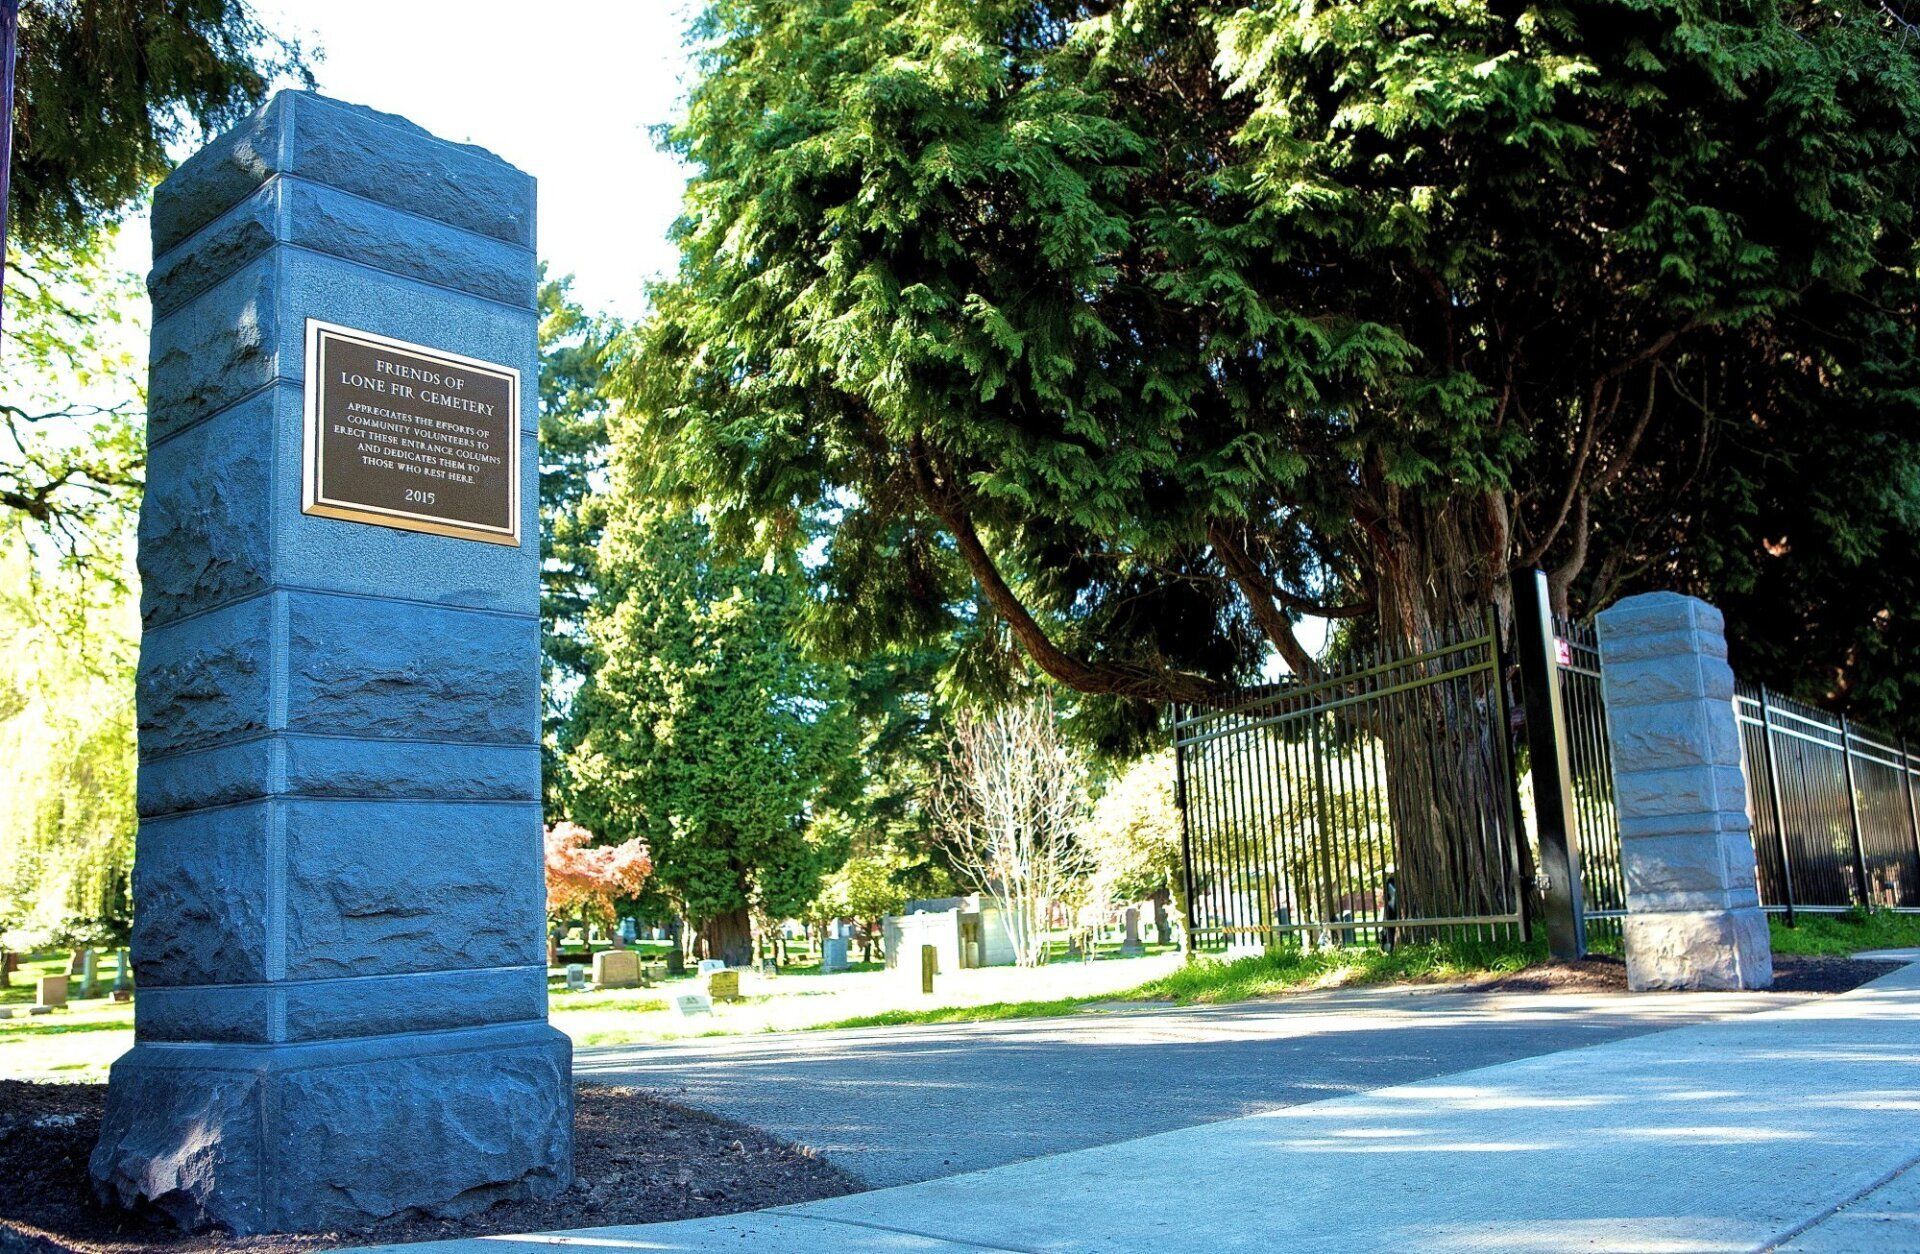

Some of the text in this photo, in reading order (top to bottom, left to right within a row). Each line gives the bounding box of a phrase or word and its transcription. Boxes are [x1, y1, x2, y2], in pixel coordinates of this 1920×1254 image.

[376, 359, 465, 391] FRIENDS OF
[341, 371, 495, 416] LONE FIR CEMETERY
[347, 402, 490, 439] APPRECIATES THE EFFORTS OF
[347, 415, 489, 451] COMMUNITY VOLUNTEERS TO
[334, 424, 501, 465] ERECT THESE ENTRANCE COLUMNS
[357, 442, 480, 473] AND DEDICATES THEM TO
[362, 455, 394, 469] THOSE
[397, 462, 422, 474] WHO
[424, 467, 446, 479] REST
[405, 488, 436, 505] 2015
